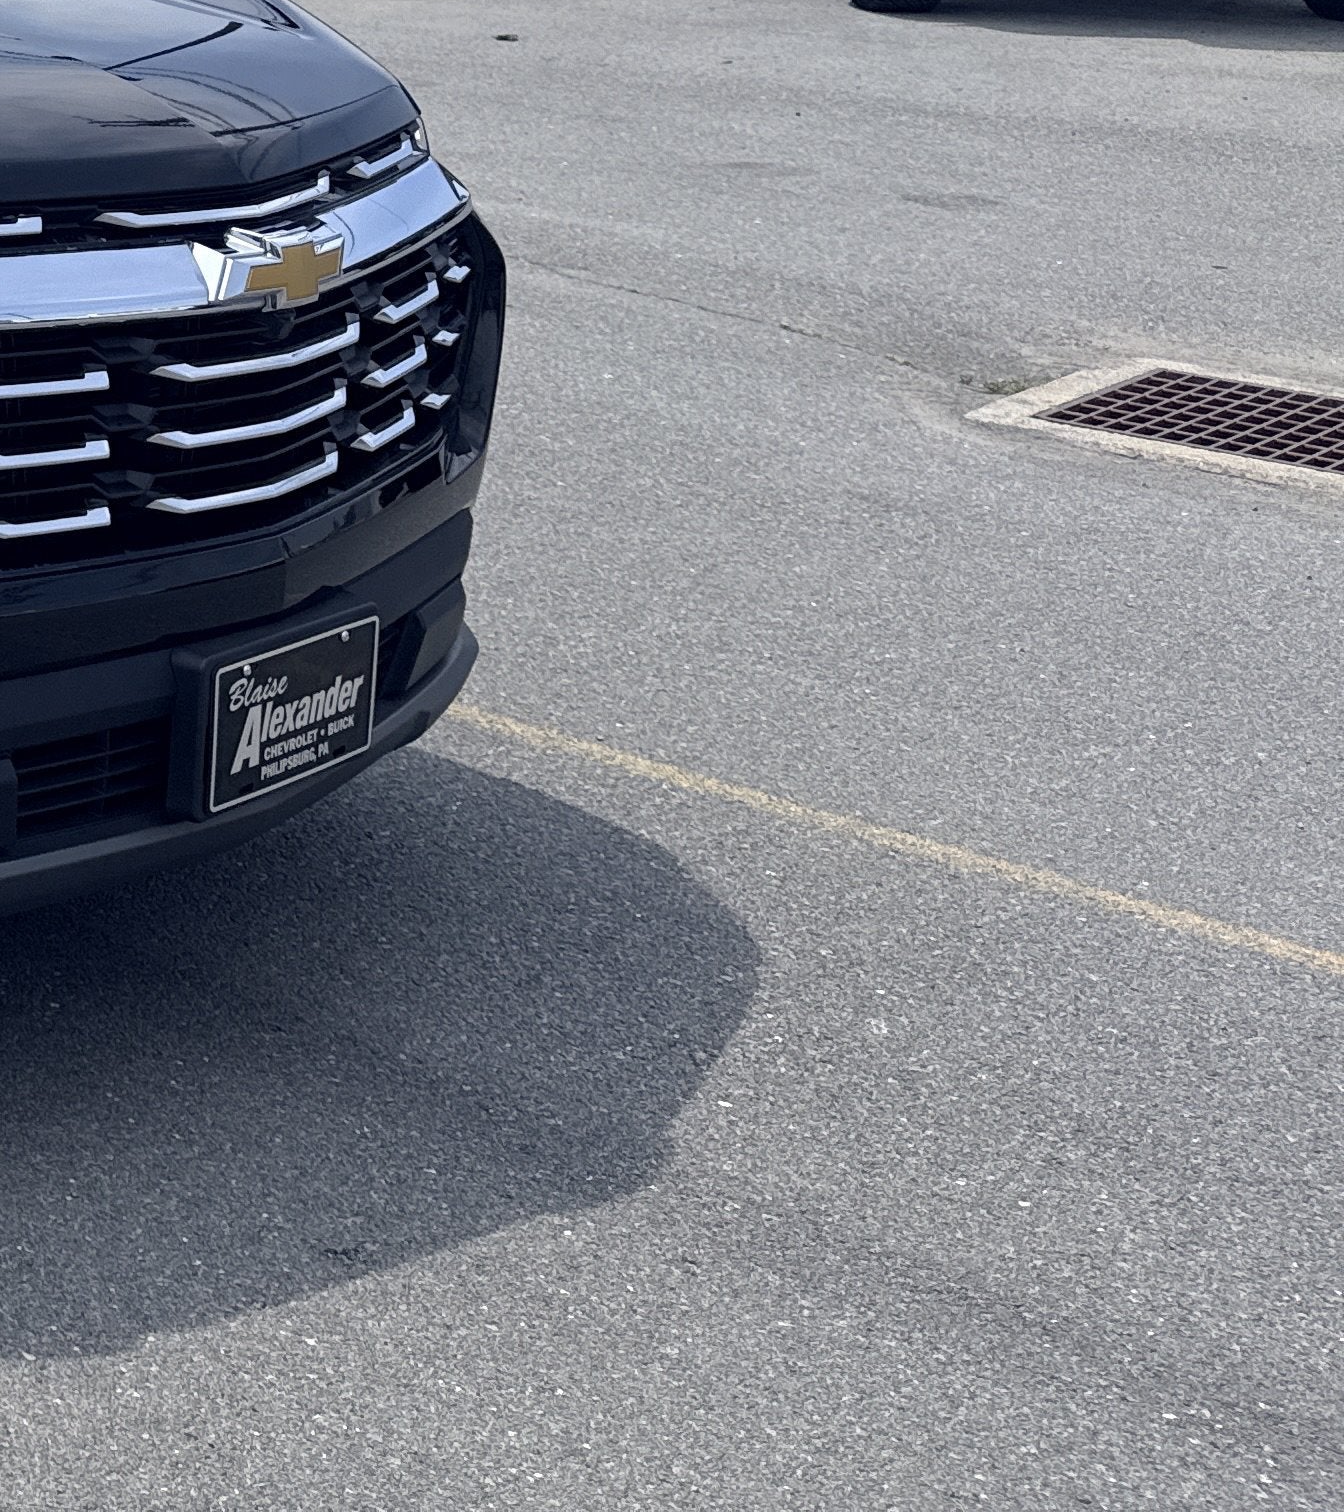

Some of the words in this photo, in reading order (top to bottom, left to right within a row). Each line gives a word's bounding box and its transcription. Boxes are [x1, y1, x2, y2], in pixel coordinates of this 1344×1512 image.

[228, 675, 288, 712] Blaise
[230, 674, 365, 776] Alexander
[263, 731, 318, 761] CHEVROLET
[327, 713, 355, 737] BUICK
[317, 741, 330, 758] PA
